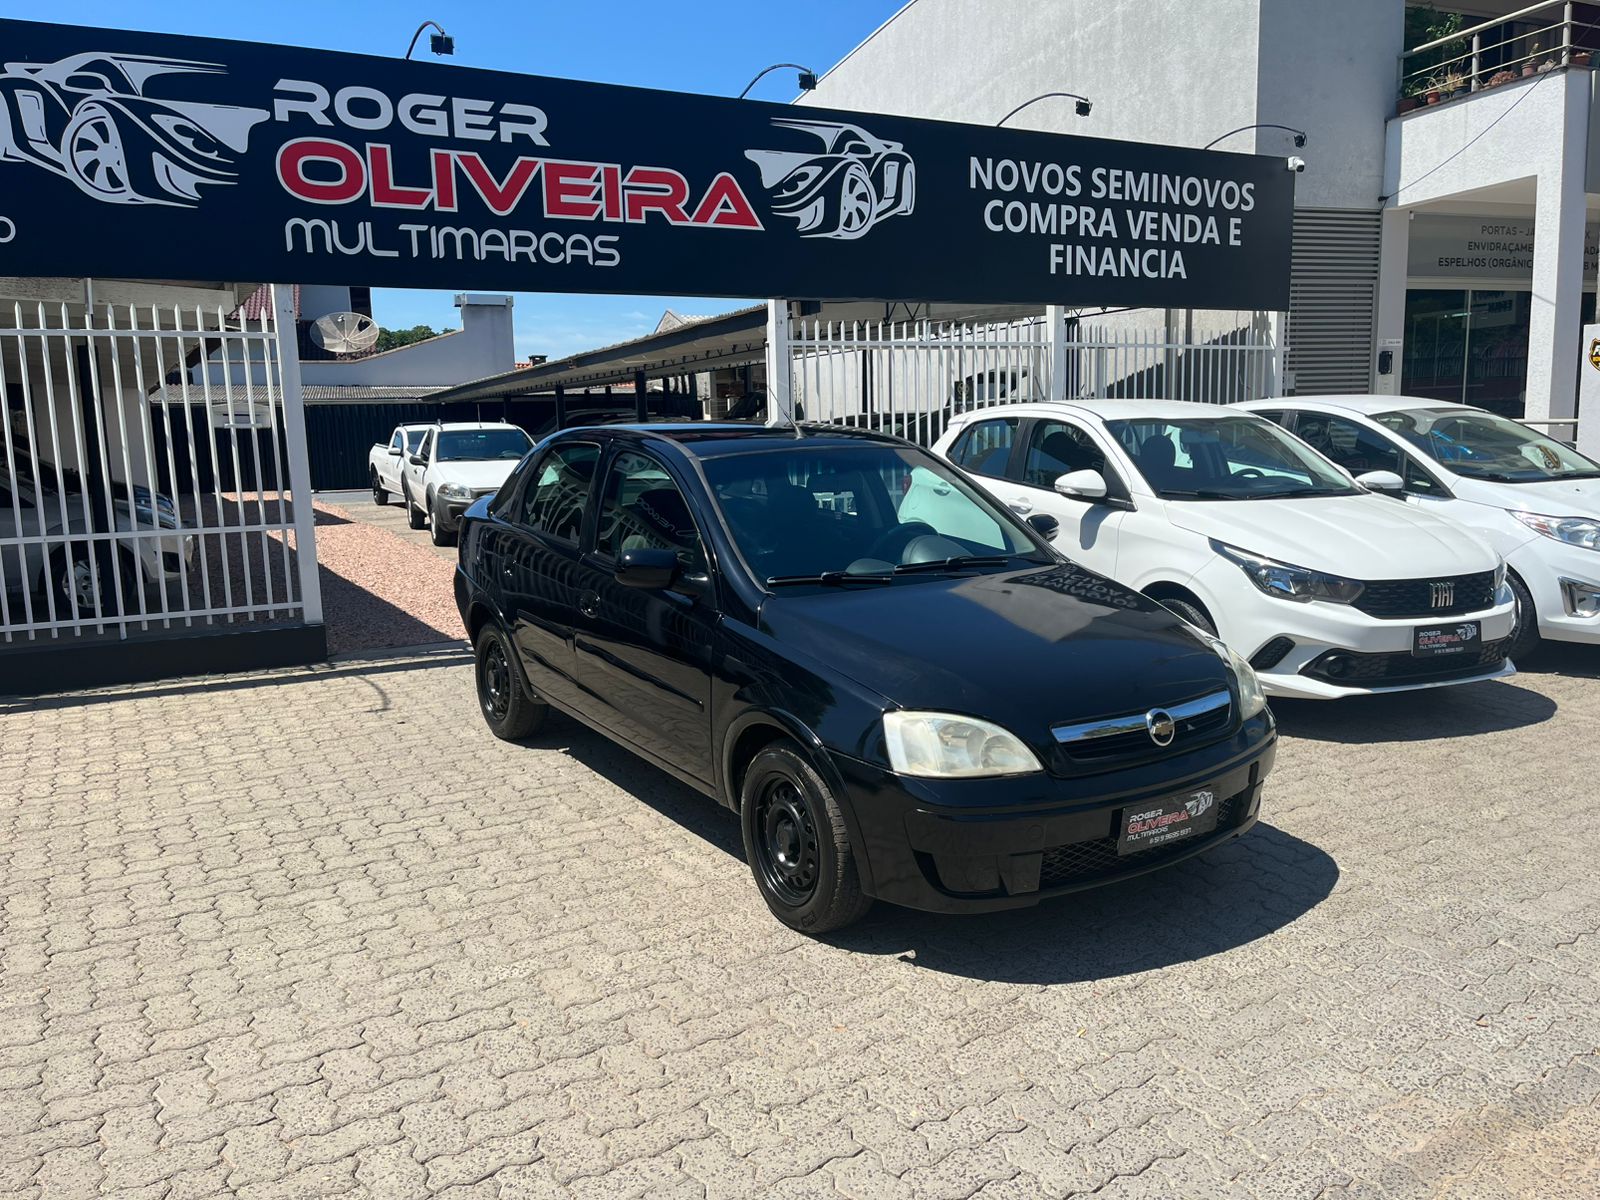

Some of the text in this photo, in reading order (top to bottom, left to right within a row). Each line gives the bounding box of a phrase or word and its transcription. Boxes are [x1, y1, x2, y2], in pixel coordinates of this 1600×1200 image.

[273, 79, 550, 146] ROGER
[275, 137, 765, 231] OLIVEIRA
[969, 156, 1255, 212] NOVOS SEMINOVOS
[983, 200, 1242, 246] COMPRA VENDA E
[1481, 225, 1518, 237] PORTAS
[284, 217, 620, 267] MULTIMARCAS
[1050, 243, 1187, 279] FINANCIA
[1438, 257, 1487, 268] ESPELHOS
[1430, 582, 1455, 608] FIAT
[1128, 810, 1189, 834] OLIVEIRA
[1129, 809, 1163, 823] ROGER
